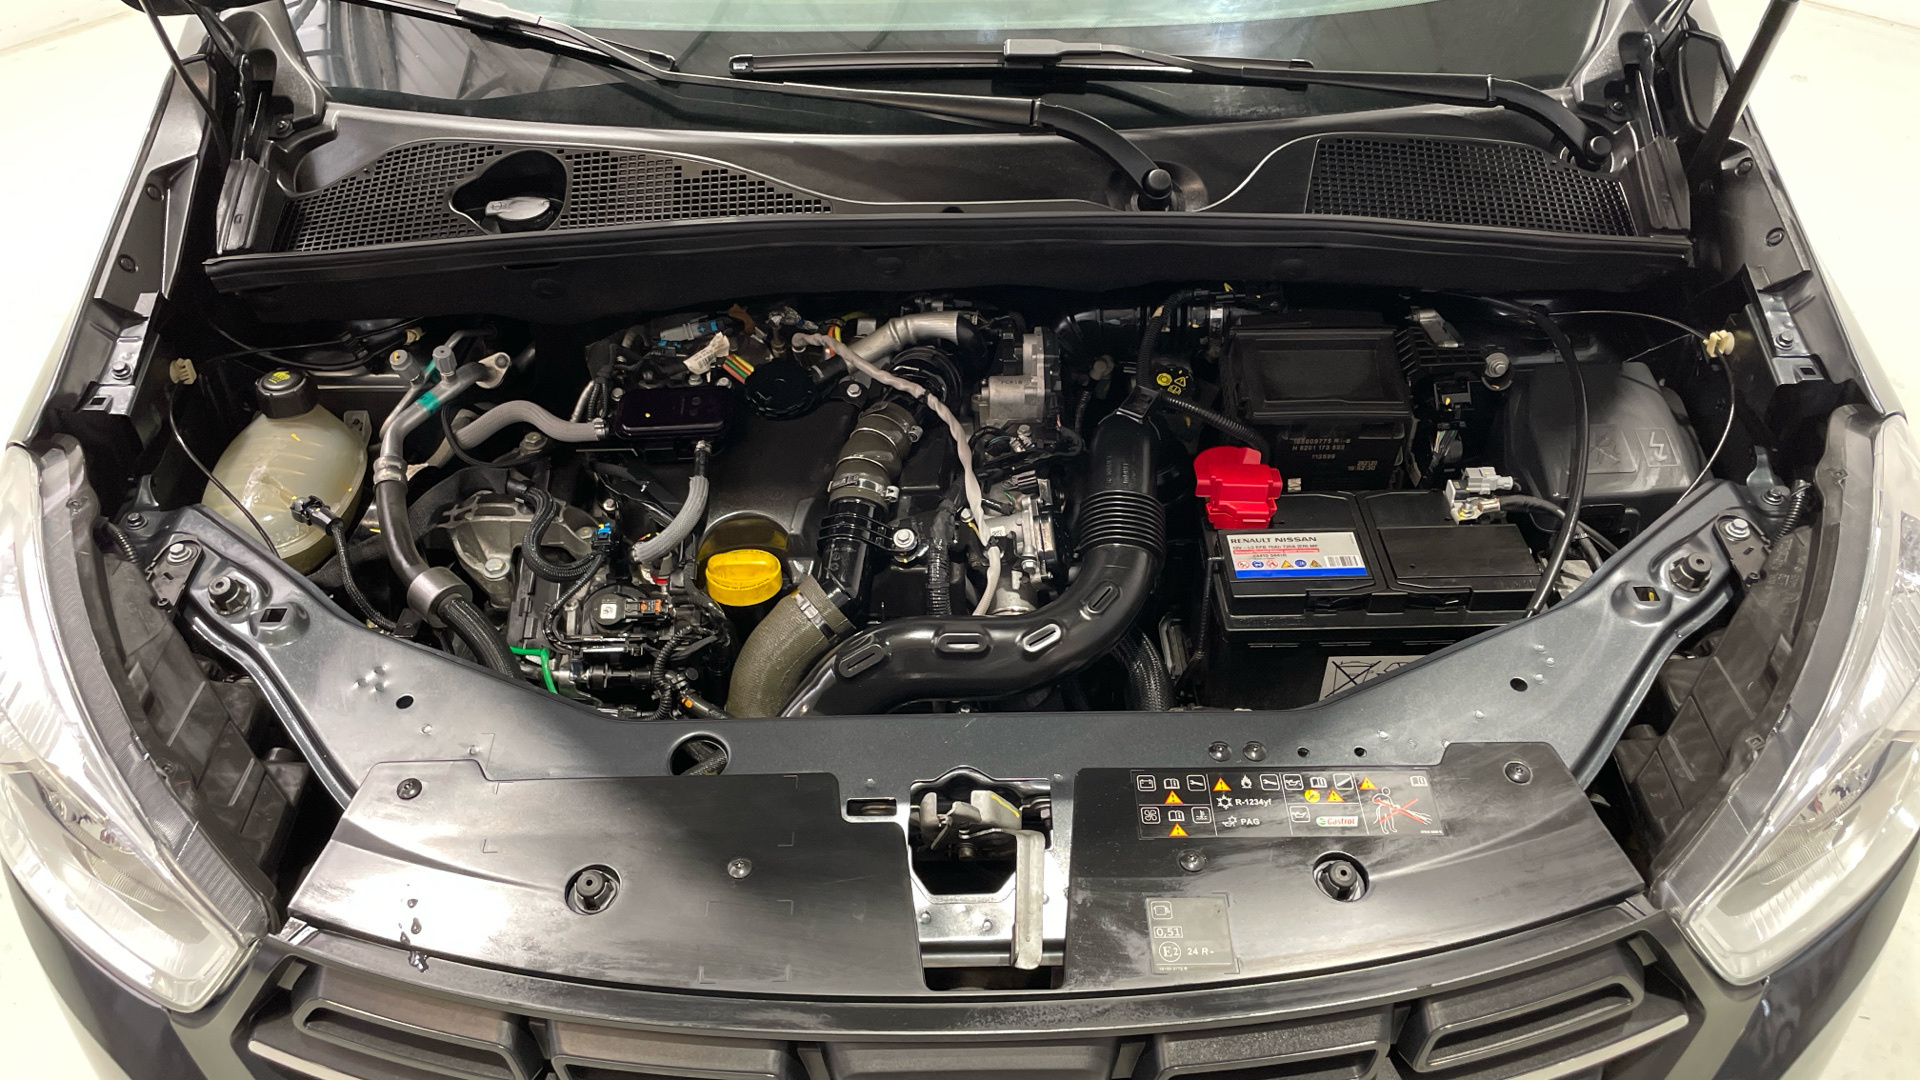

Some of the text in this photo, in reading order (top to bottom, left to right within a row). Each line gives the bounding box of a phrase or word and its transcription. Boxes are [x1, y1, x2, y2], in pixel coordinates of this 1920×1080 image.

[1235, 798, 1272, 807] R-1234yf
[1240, 818, 1261, 826] PAG
[1327, 817, 1355, 825] Castrol
[1156, 927, 1181, 938] 0,51
[1187, 947, 1199, 956] 24
